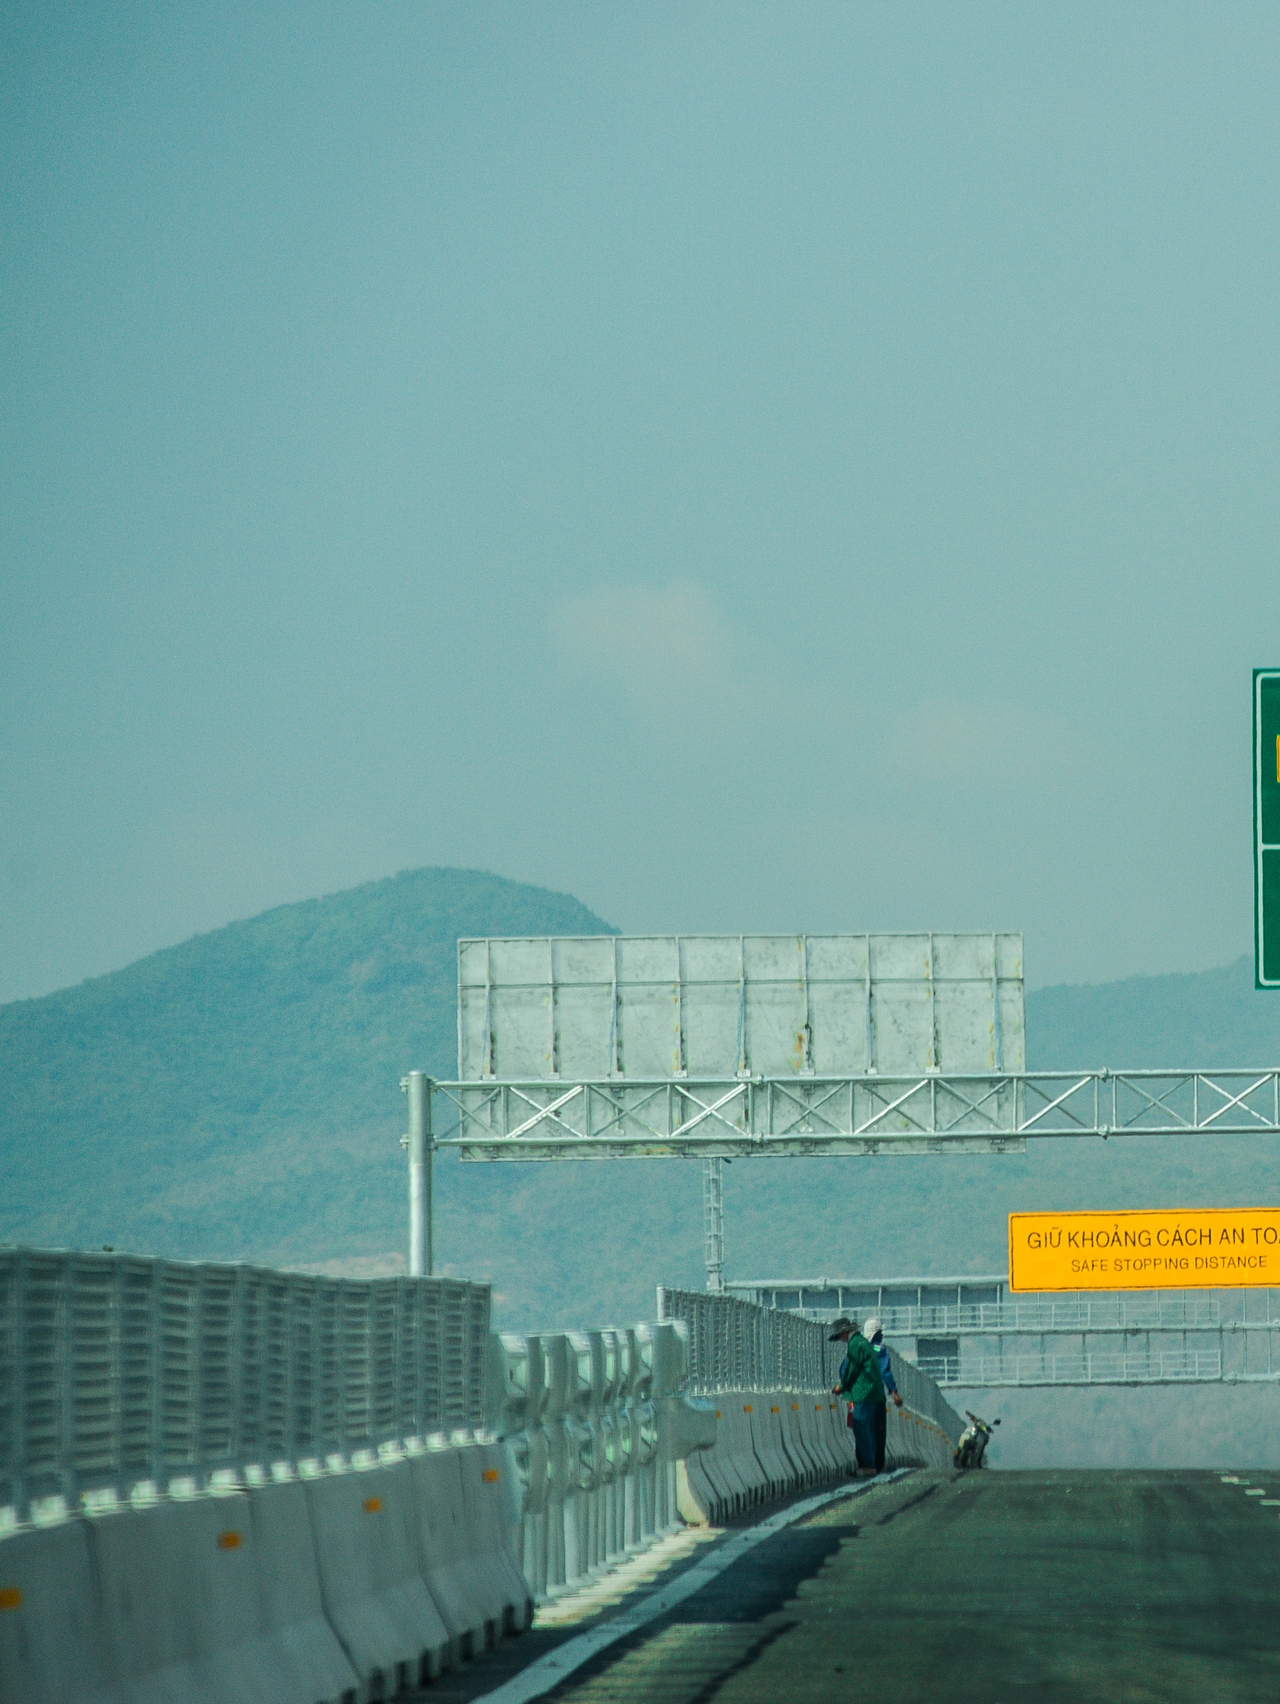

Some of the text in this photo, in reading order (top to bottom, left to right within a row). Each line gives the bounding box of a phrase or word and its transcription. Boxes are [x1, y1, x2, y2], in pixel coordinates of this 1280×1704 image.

[1027, 1226, 1062, 1250] GIỮ
[1068, 1224, 1152, 1248] KHOẢNG
[1156, 1224, 1213, 1247] CÁCH
[1219, 1229, 1246, 1246] AN
[1071, 1255, 1268, 1273] SAFE STOPPING DISTANCE
